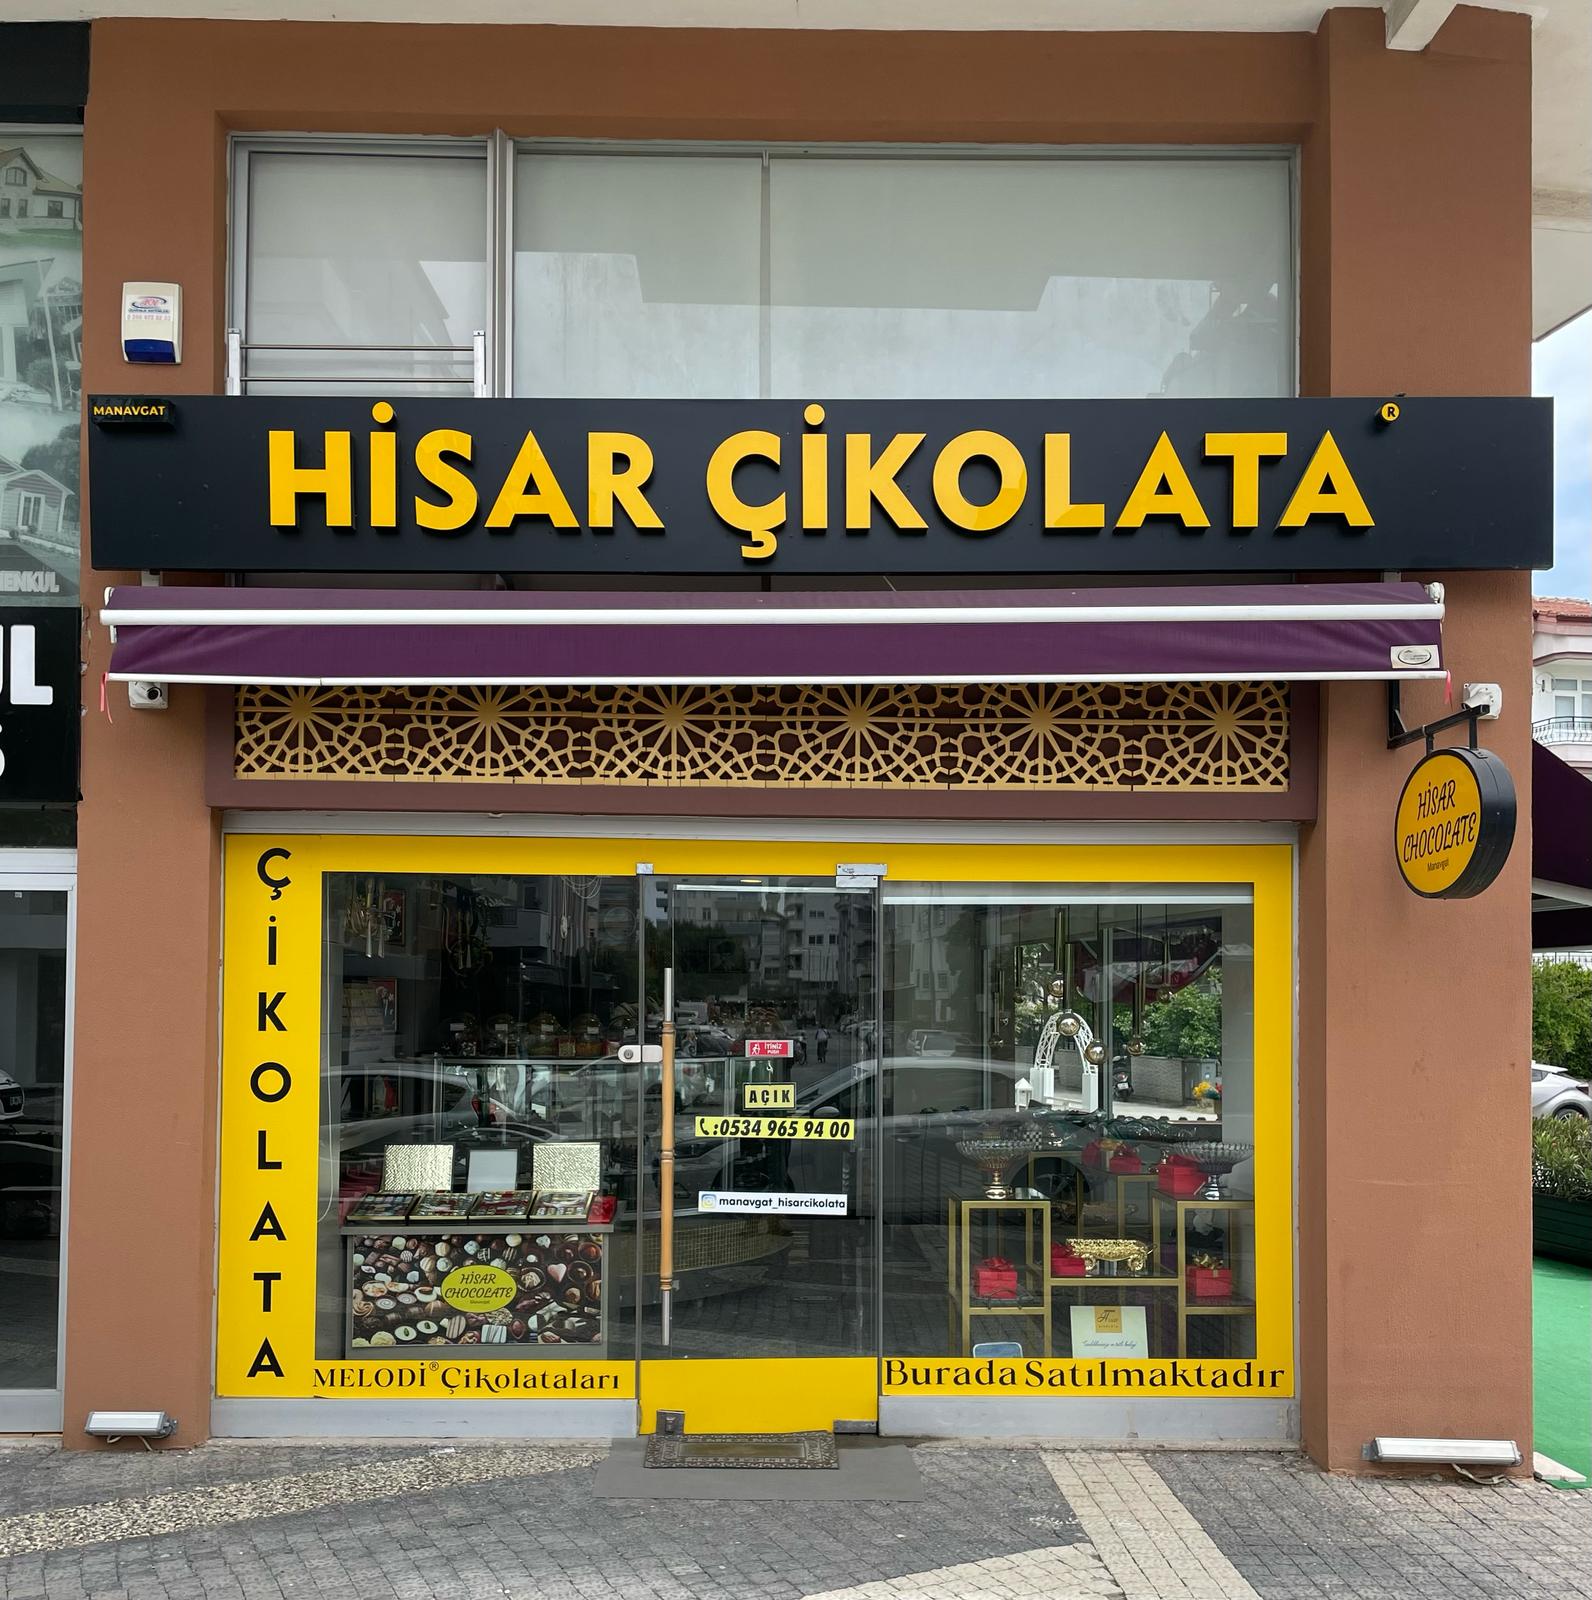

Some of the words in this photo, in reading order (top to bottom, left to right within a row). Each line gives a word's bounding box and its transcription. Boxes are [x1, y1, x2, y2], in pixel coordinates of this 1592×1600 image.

[93, 406, 166, 416] MANAVGAT
[269, 402, 662, 530] HİSAR
[707, 404, 1374, 559] ÇİKOLATA
[0, 570, 60, 593] ENKUL
[0, 625, 53, 705] L
[1416, 779, 1457, 821] HİSAR
[1403, 811, 1477, 863] CHOCOLATE
[749, 1089, 790, 1105] AÇIK
[246, 848, 292, 1378] ÇİKOLATA
[768, 1120, 798, 1137] 965
[804, 1121, 824, 1138] 94
[830, 1121, 850, 1138] 00
[719, 1197, 846, 1209] manavgat_hisarcikolata
[460, 1271, 497, 1285] HİSAR
[444, 1287, 513, 1299] CHOCOLATE
[441, 1367, 619, 1394] Çikolataları
[885, 1360, 1017, 1386] Burada
[1025, 1361, 1285, 1388] Satılmaktadır
